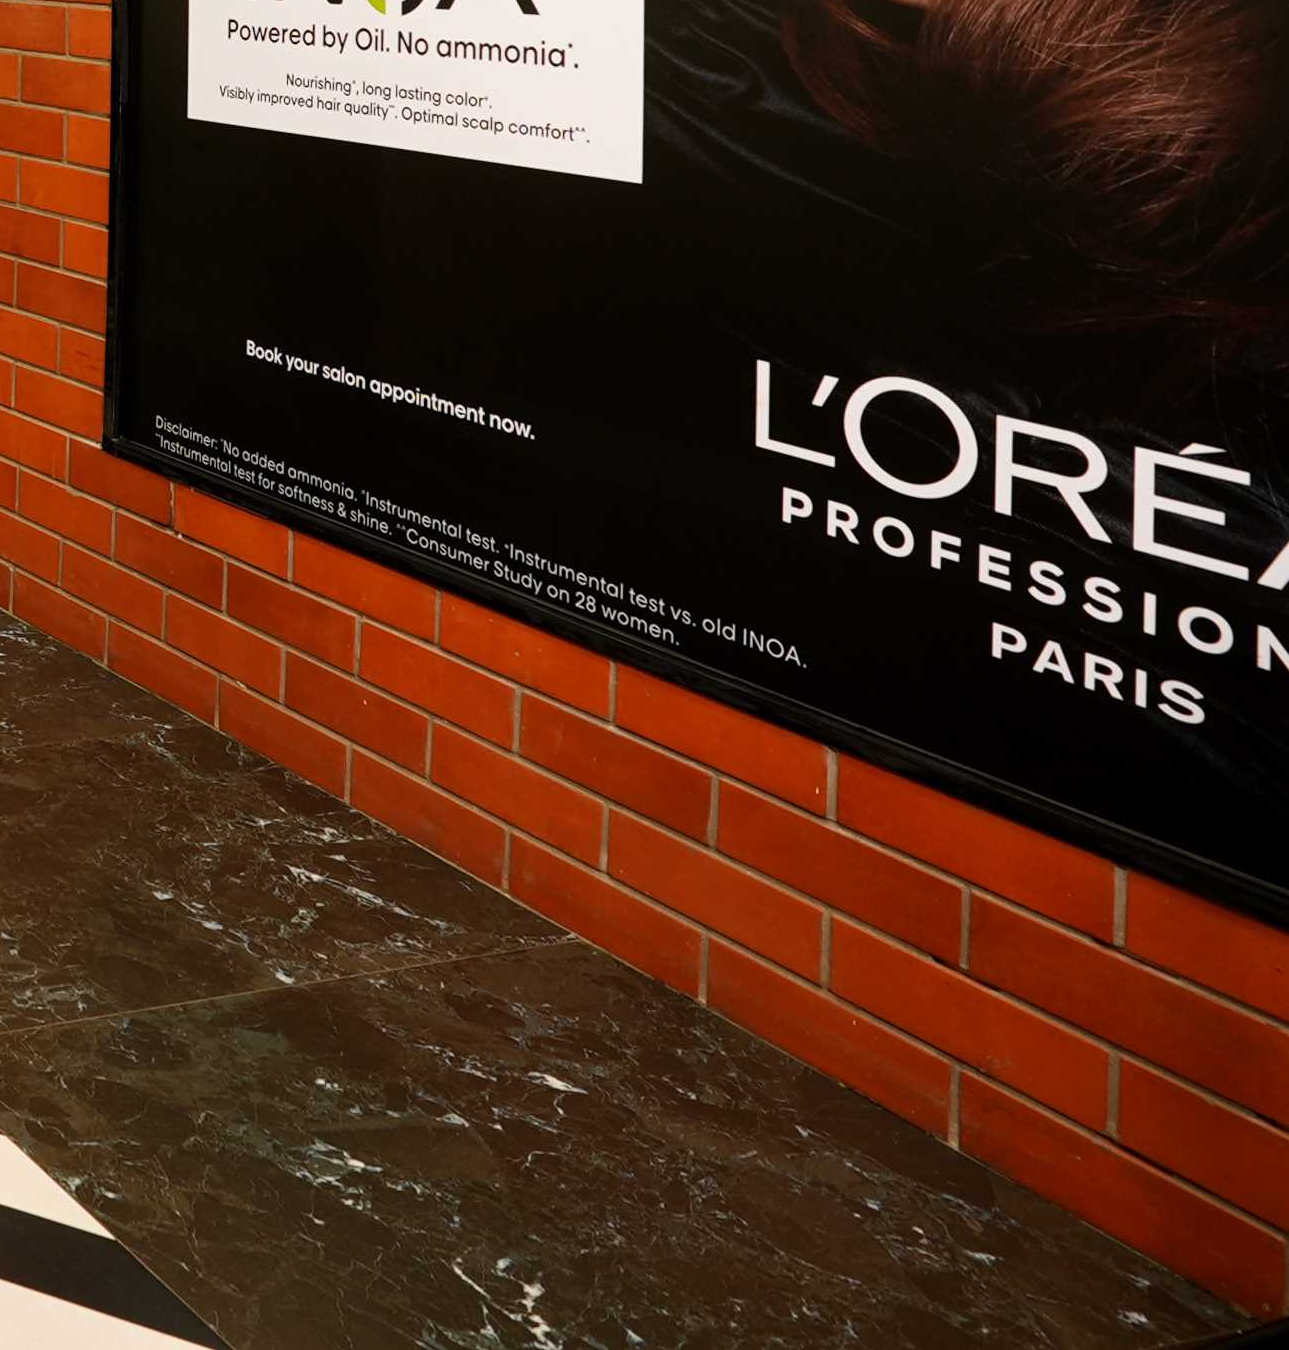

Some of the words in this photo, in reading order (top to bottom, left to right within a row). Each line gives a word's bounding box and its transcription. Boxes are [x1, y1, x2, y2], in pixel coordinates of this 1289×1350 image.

[228, 19, 316, 47] Powered
[323, 25, 348, 54] by
[355, 28, 390, 53] Oil.
[397, 31, 429, 55] No
[219, 85, 255, 104] Visibly
[257, 89, 313, 108] improved
[317, 96, 341, 112] hair
[401, 107, 458, 126] Optimal
[462, 117, 504, 135] scalp
[363, 81, 392, 100] long
[395, 84, 442, 106] lasting
[246, 339, 283, 366] Book
[285, 354, 320, 376] your
[322, 364, 366, 390] salon
[370, 378, 486, 425] appointment
[489, 412, 536, 440] now.
[755, 359, 1289, 591] L'ORÉ
[234, 463, 256, 484] test
[258, 472, 276, 491] for
[278, 482, 335, 514] softness
[337, 501, 347, 518] &
[350, 508, 393, 535] shine.
[493, 560, 543, 595] Study
[546, 584, 571, 604] on
[575, 591, 597, 614] 28
[601, 603, 680, 646] women.
[242, 451, 285, 475] added
[288, 467, 358, 501] ammonia.
[466, 528, 500, 554] test.
[629, 587, 666, 616] test
[670, 605, 697, 627] vs.
[702, 617, 736, 641] old
[743, 628, 808, 669] INOA.
[991, 621, 1207, 725] PARIS
